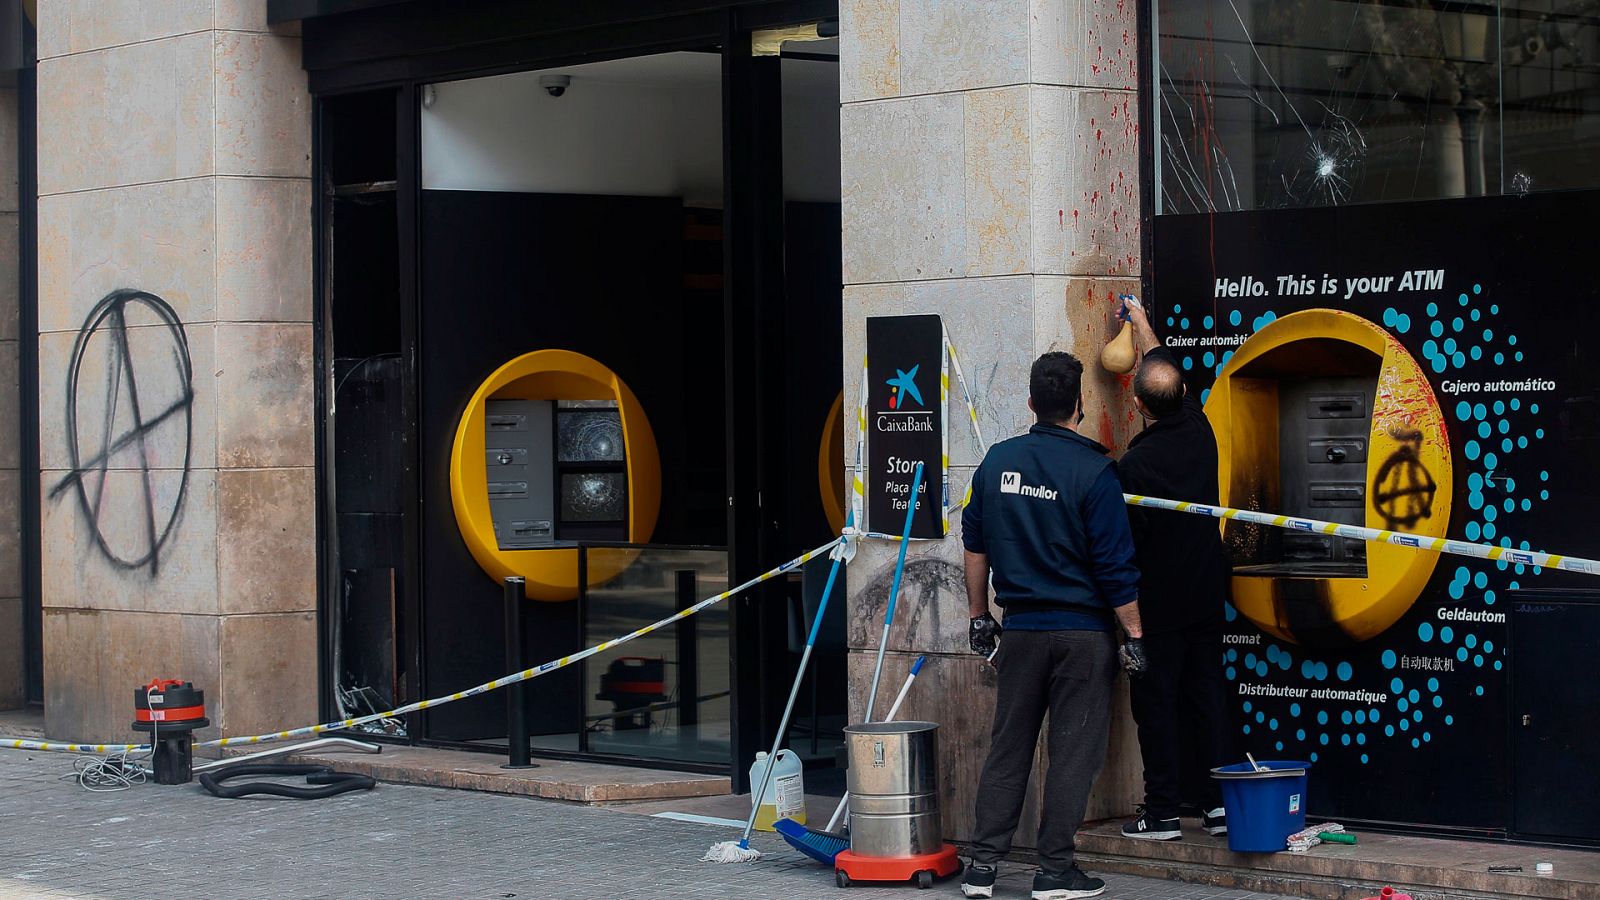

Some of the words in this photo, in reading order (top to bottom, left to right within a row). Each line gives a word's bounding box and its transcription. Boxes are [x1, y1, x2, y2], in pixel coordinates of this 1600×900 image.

[1214, 275, 1269, 298] Hello.
[1276, 274, 1316, 296] This
[1321, 273, 1338, 295] is
[1344, 276, 1394, 300] your
[1397, 269, 1445, 292] ATM
[1165, 335, 1199, 347] Caixer
[1200, 333, 1249, 346] automàti
[1441, 379, 1481, 396] Cajero
[1483, 377, 1556, 392] automático
[877, 415, 934, 432] CaixaBank
[885, 481, 910, 497] Plaça
[912, 481, 927, 494] el
[1020, 485, 1058, 501] mullor
[892, 498, 921, 510] Teae
[1401, 654, 1455, 672] 自动取款机
[1238, 682, 1309, 699] Distributeur
[1311, 687, 1387, 704] automatique
